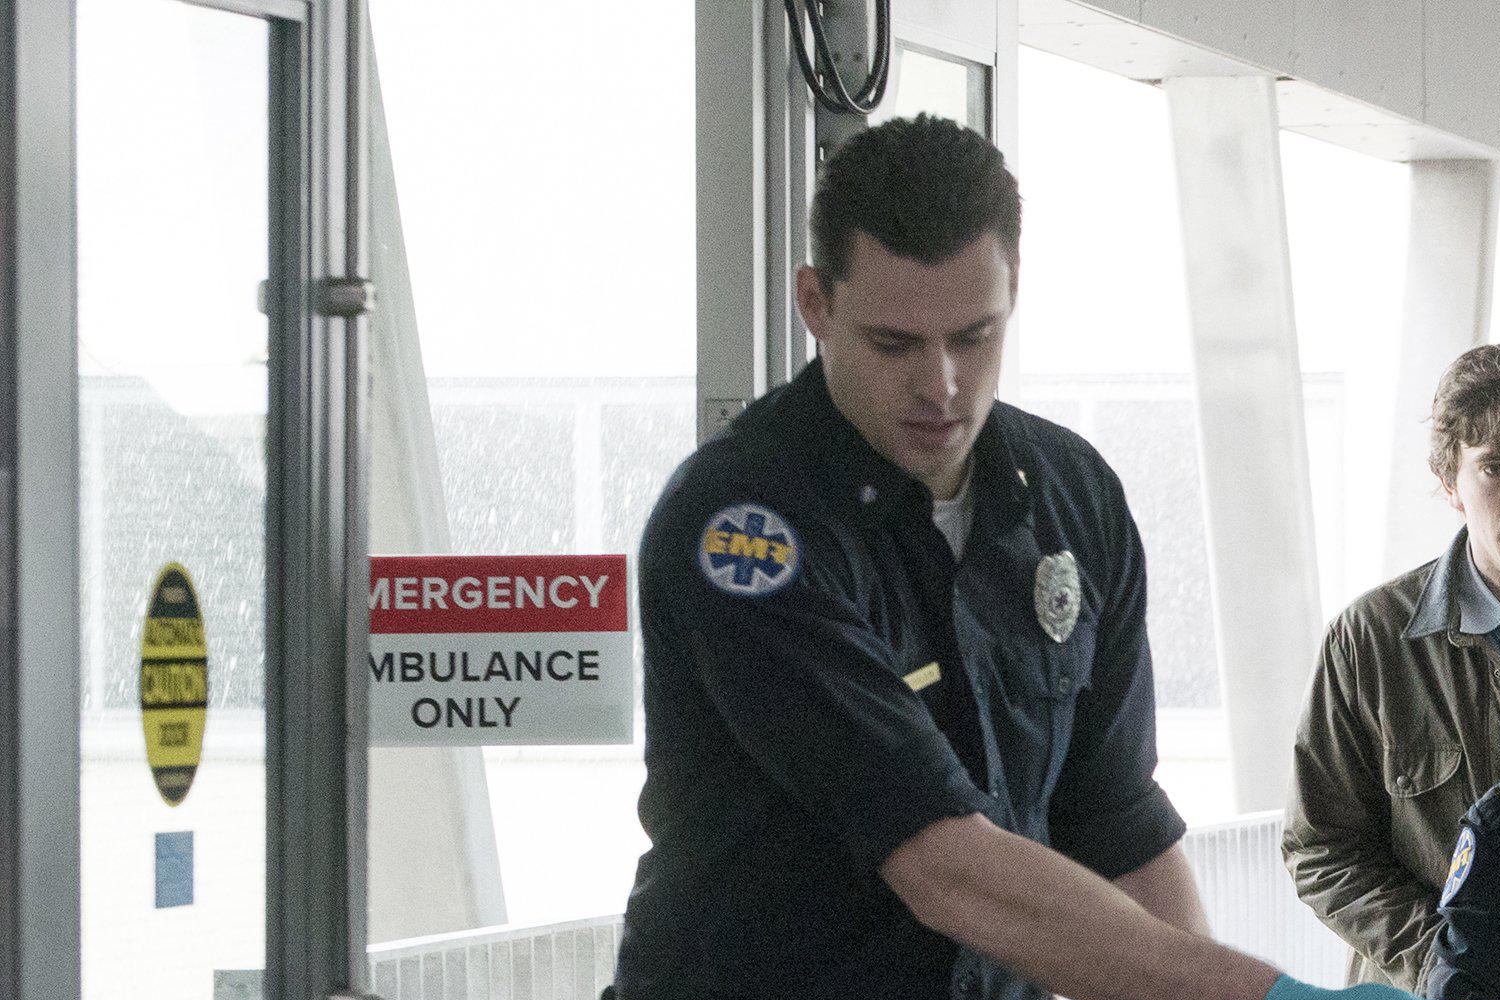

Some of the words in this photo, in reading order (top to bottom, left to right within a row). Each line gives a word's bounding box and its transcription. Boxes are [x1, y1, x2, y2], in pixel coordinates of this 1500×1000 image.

[369, 575, 609, 610] MERGENCY
[369, 650, 599, 682] MBULANCE
[411, 697, 521, 728] ONLY
